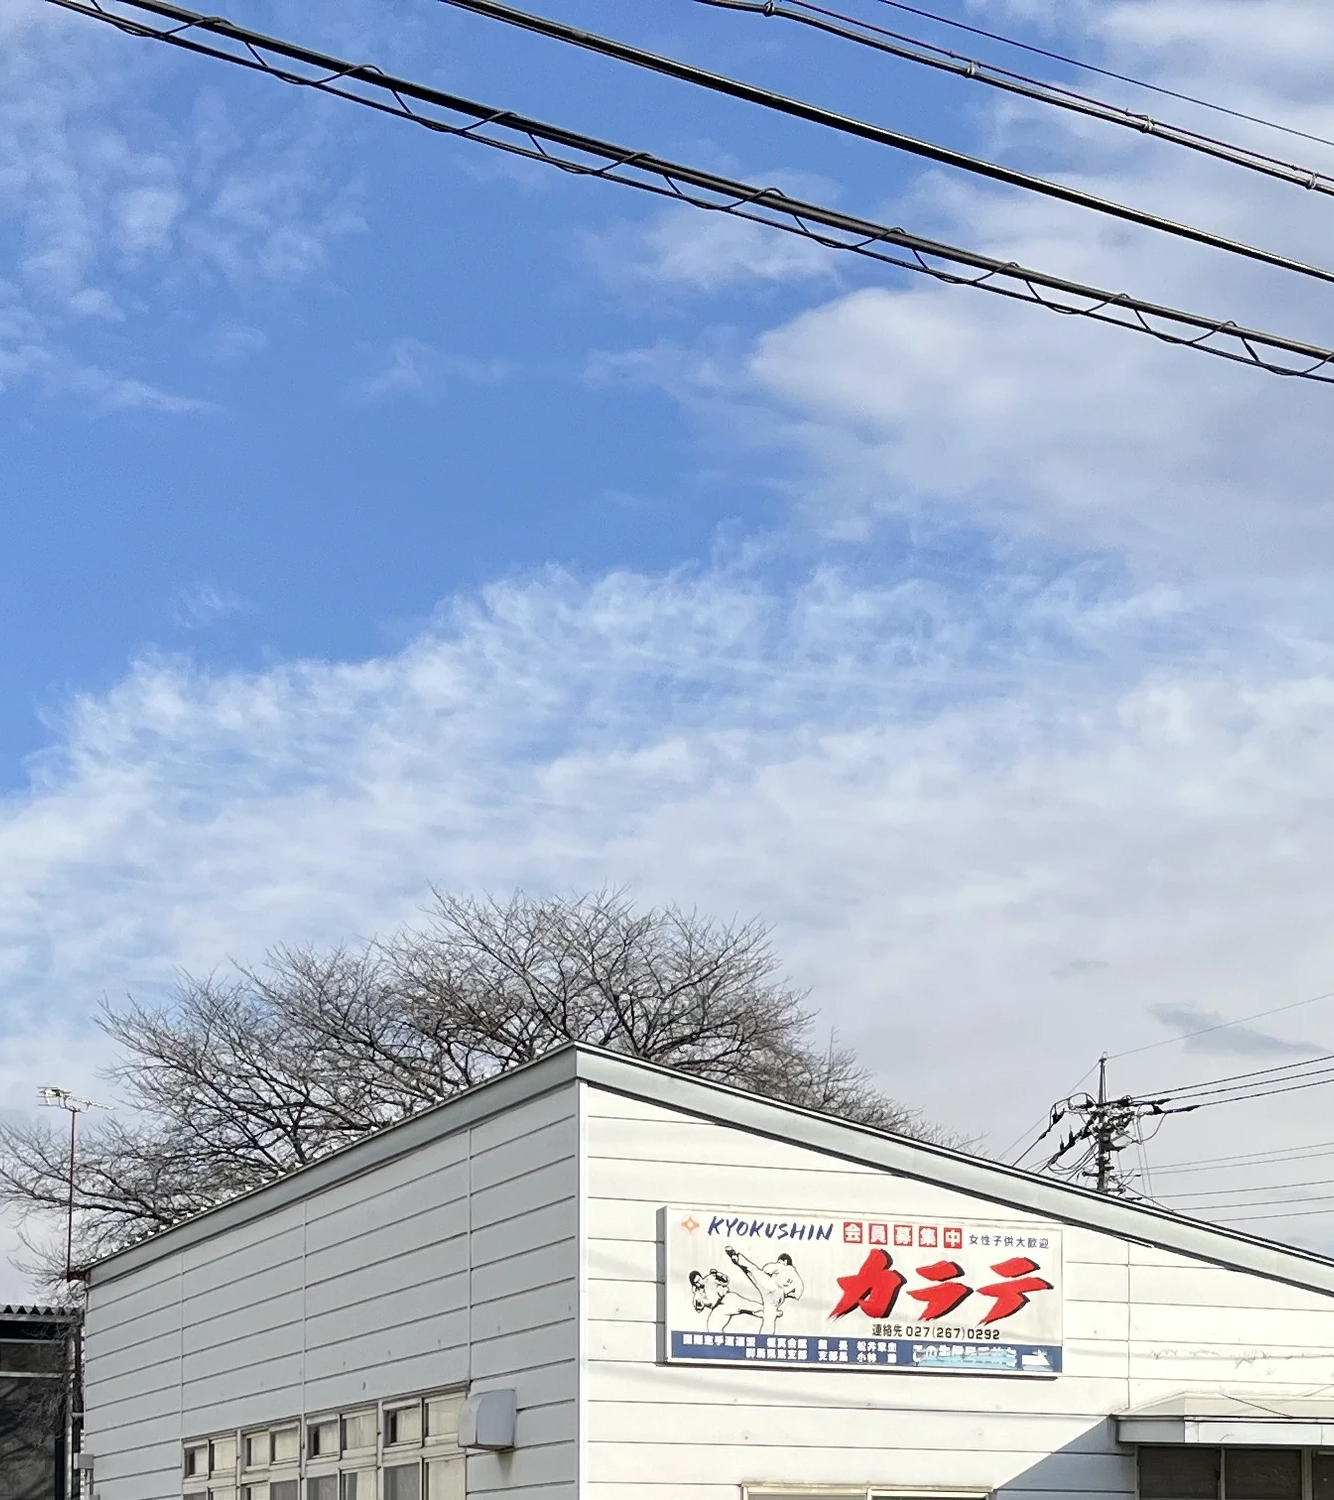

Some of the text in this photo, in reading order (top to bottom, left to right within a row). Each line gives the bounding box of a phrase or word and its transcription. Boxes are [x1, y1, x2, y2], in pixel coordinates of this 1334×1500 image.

[707, 1215, 835, 1241] KYOKUSHIN
[844, 1222, 962, 1248] 会員募集中
[826, 1248, 1055, 1325] カラテ
[872, 1323, 1001, 1340] 連絡先 027(267)0292
